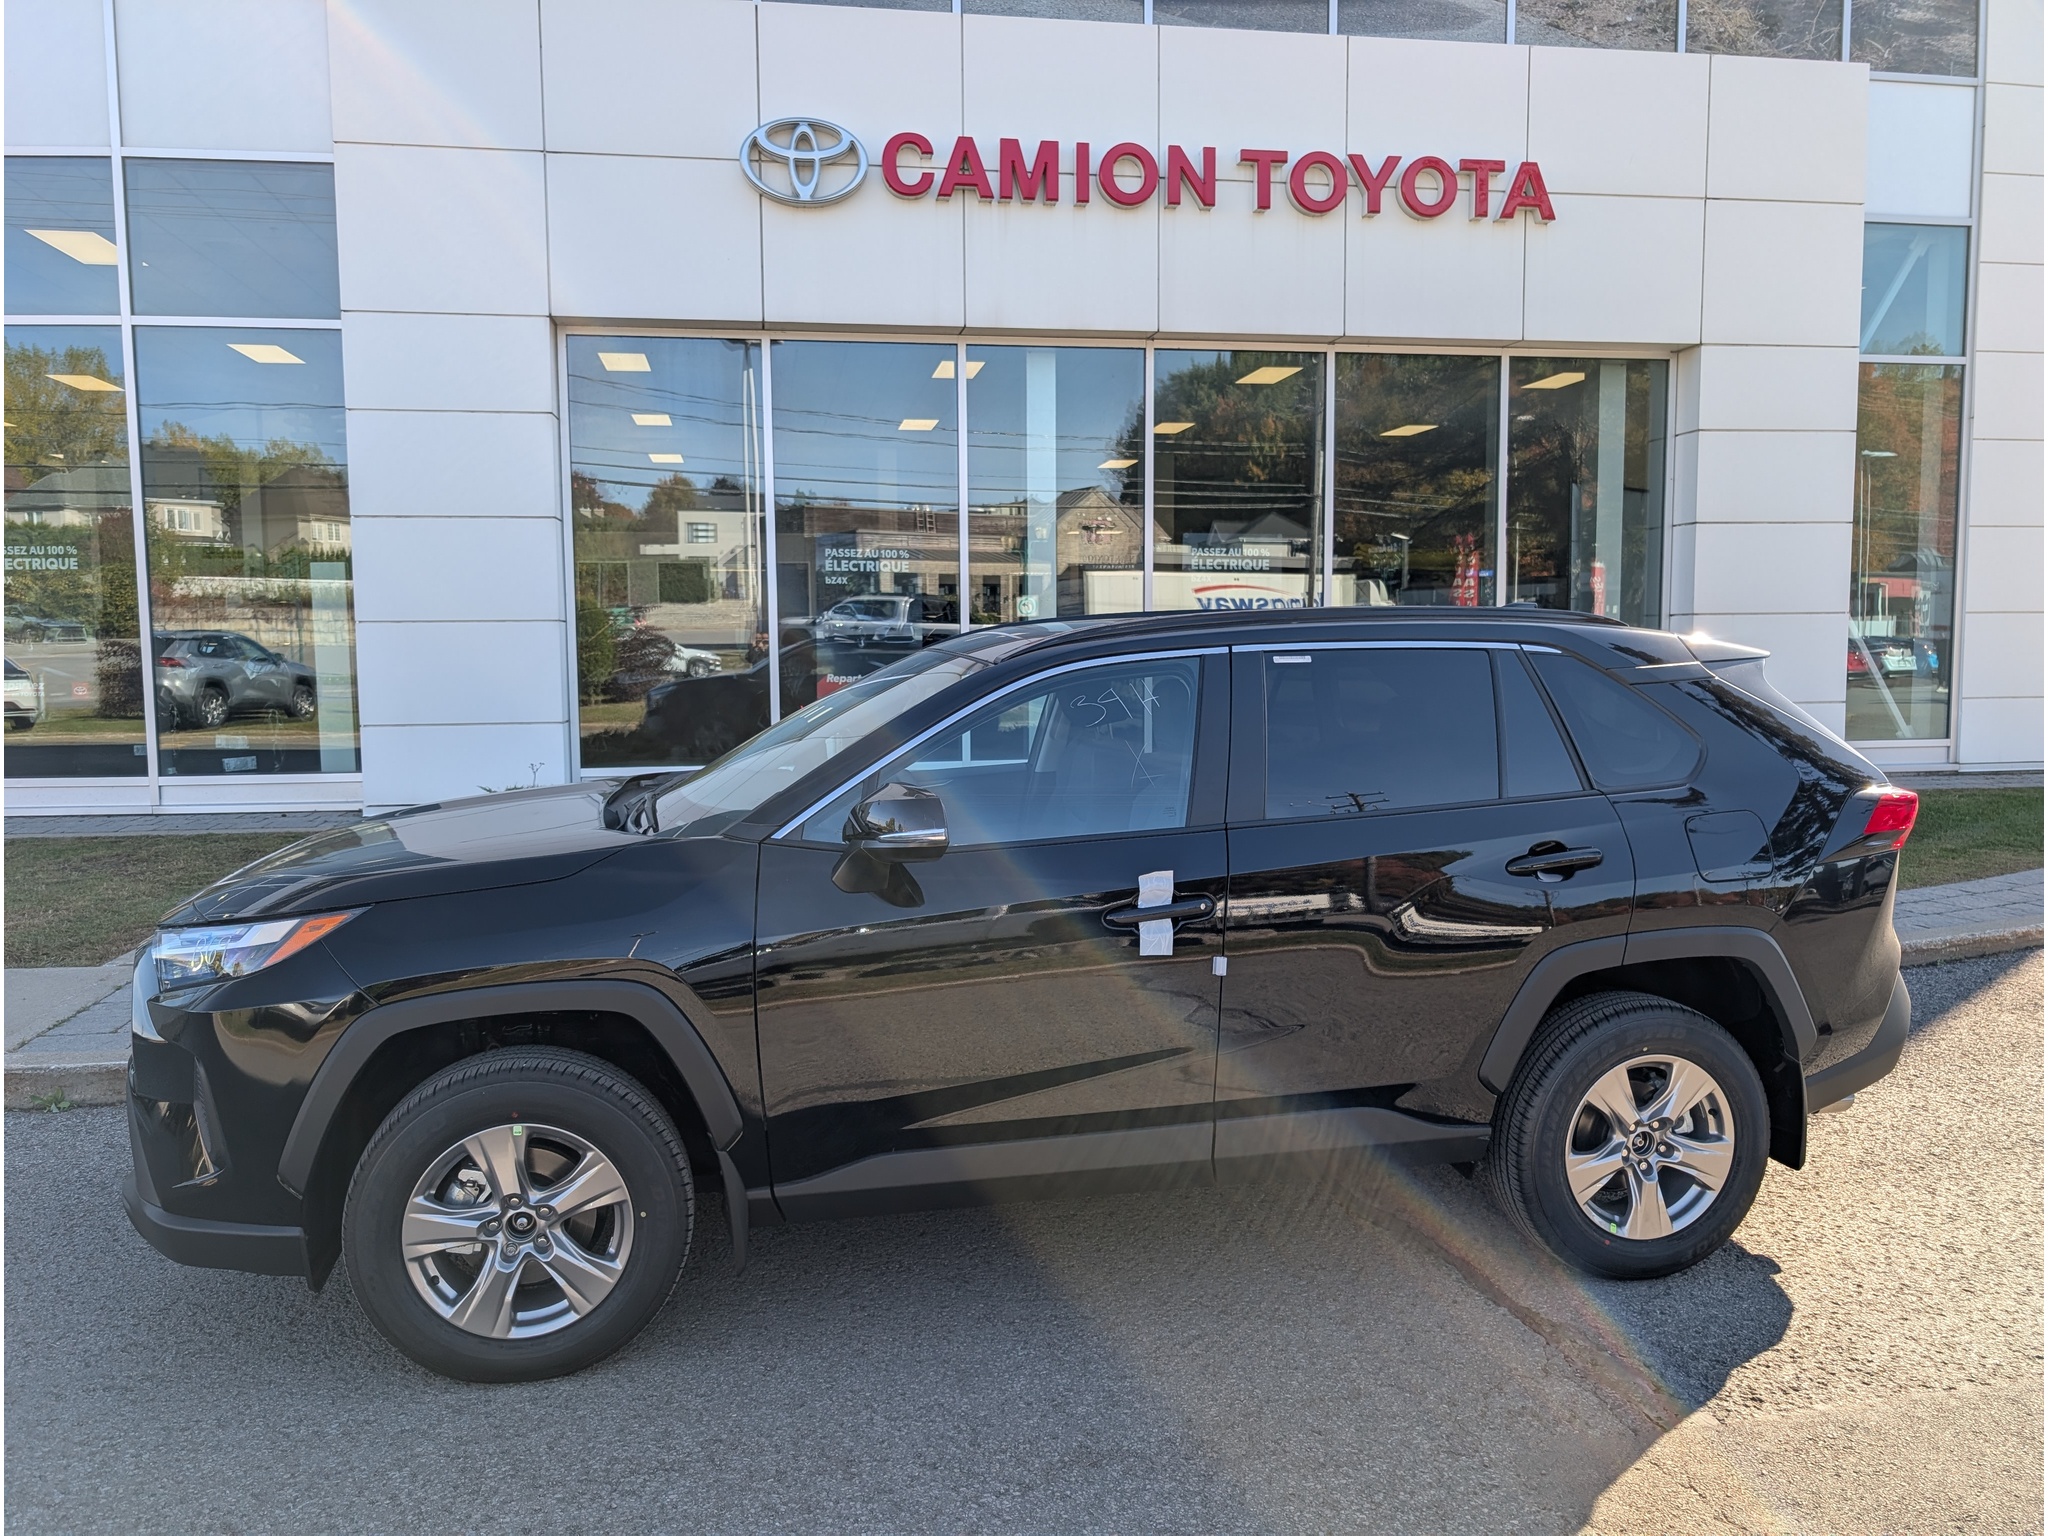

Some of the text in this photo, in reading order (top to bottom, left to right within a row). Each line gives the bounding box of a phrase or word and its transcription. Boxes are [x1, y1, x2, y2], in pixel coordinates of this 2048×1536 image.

[882, 132, 1556, 225] CAMION TOYOTA
[29, 546, 44, 555] AU
[46, 545, 64, 555] 100
[66, 545, 77, 555] %
[825, 548, 909, 559] PASSEZ AU 100 %
[1191, 548, 1226, 556] PASSEZ
[1228, 548, 1241, 557] AU
[1243, 548, 1259, 556] 100
[1260, 548, 1270, 557] %
[825, 557, 909, 572] ÉLECTRIQUE
[1191, 556, 1270, 571] ÉLECTRIQUE
[825, 576, 848, 585] bZ4X
